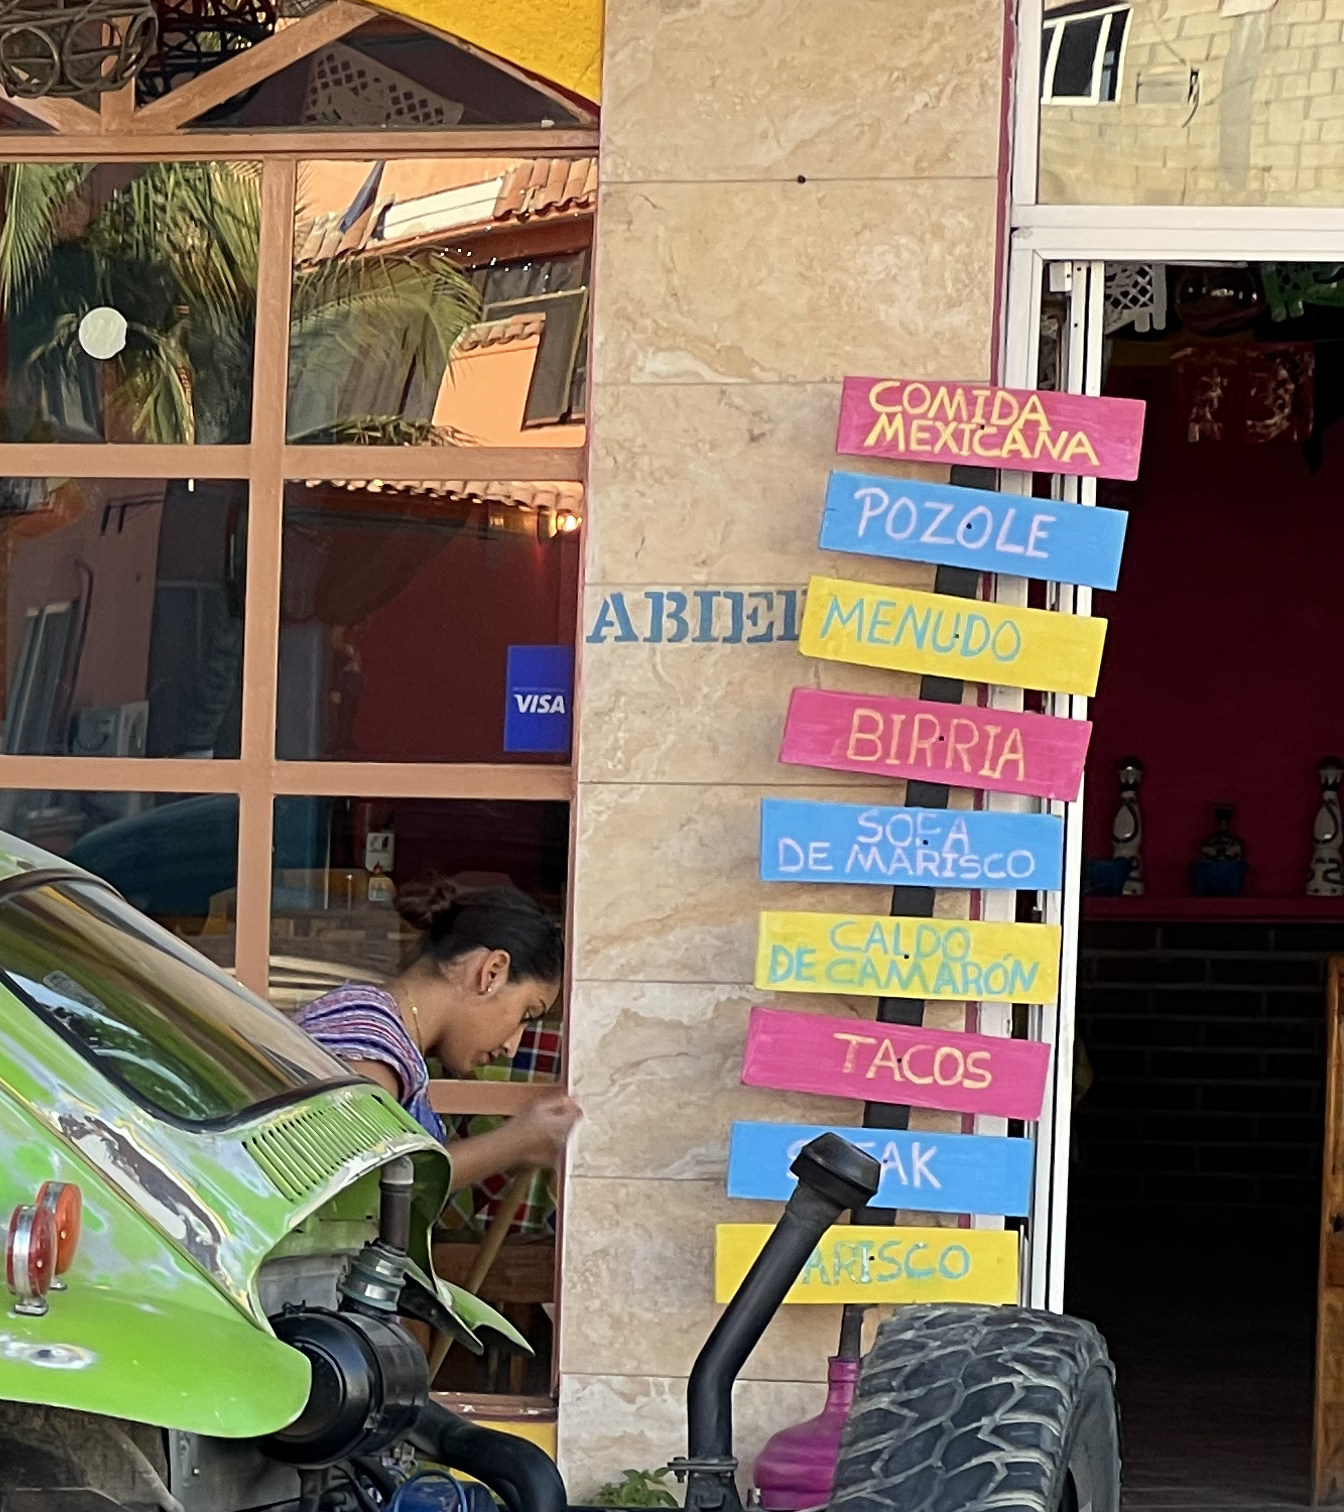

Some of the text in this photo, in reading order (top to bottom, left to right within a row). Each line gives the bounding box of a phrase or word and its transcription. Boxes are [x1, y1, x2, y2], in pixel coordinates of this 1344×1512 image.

[870, 381, 1050, 432] COMIDA
[864, 412, 1100, 466] MEXICANA
[853, 486, 1056, 559] POZOLE
[820, 595, 1022, 662] MENUDO
[513, 693, 566, 714] VISA
[847, 708, 1025, 781] BIRRIA
[778, 837, 1036, 879] DE MARISCO
[829, 921, 971, 962] CALDO
[768, 943, 1040, 996] DE CAMARÓN
[833, 1032, 993, 1090] TACOS
[802, 1240, 971, 1286] ARISCO
